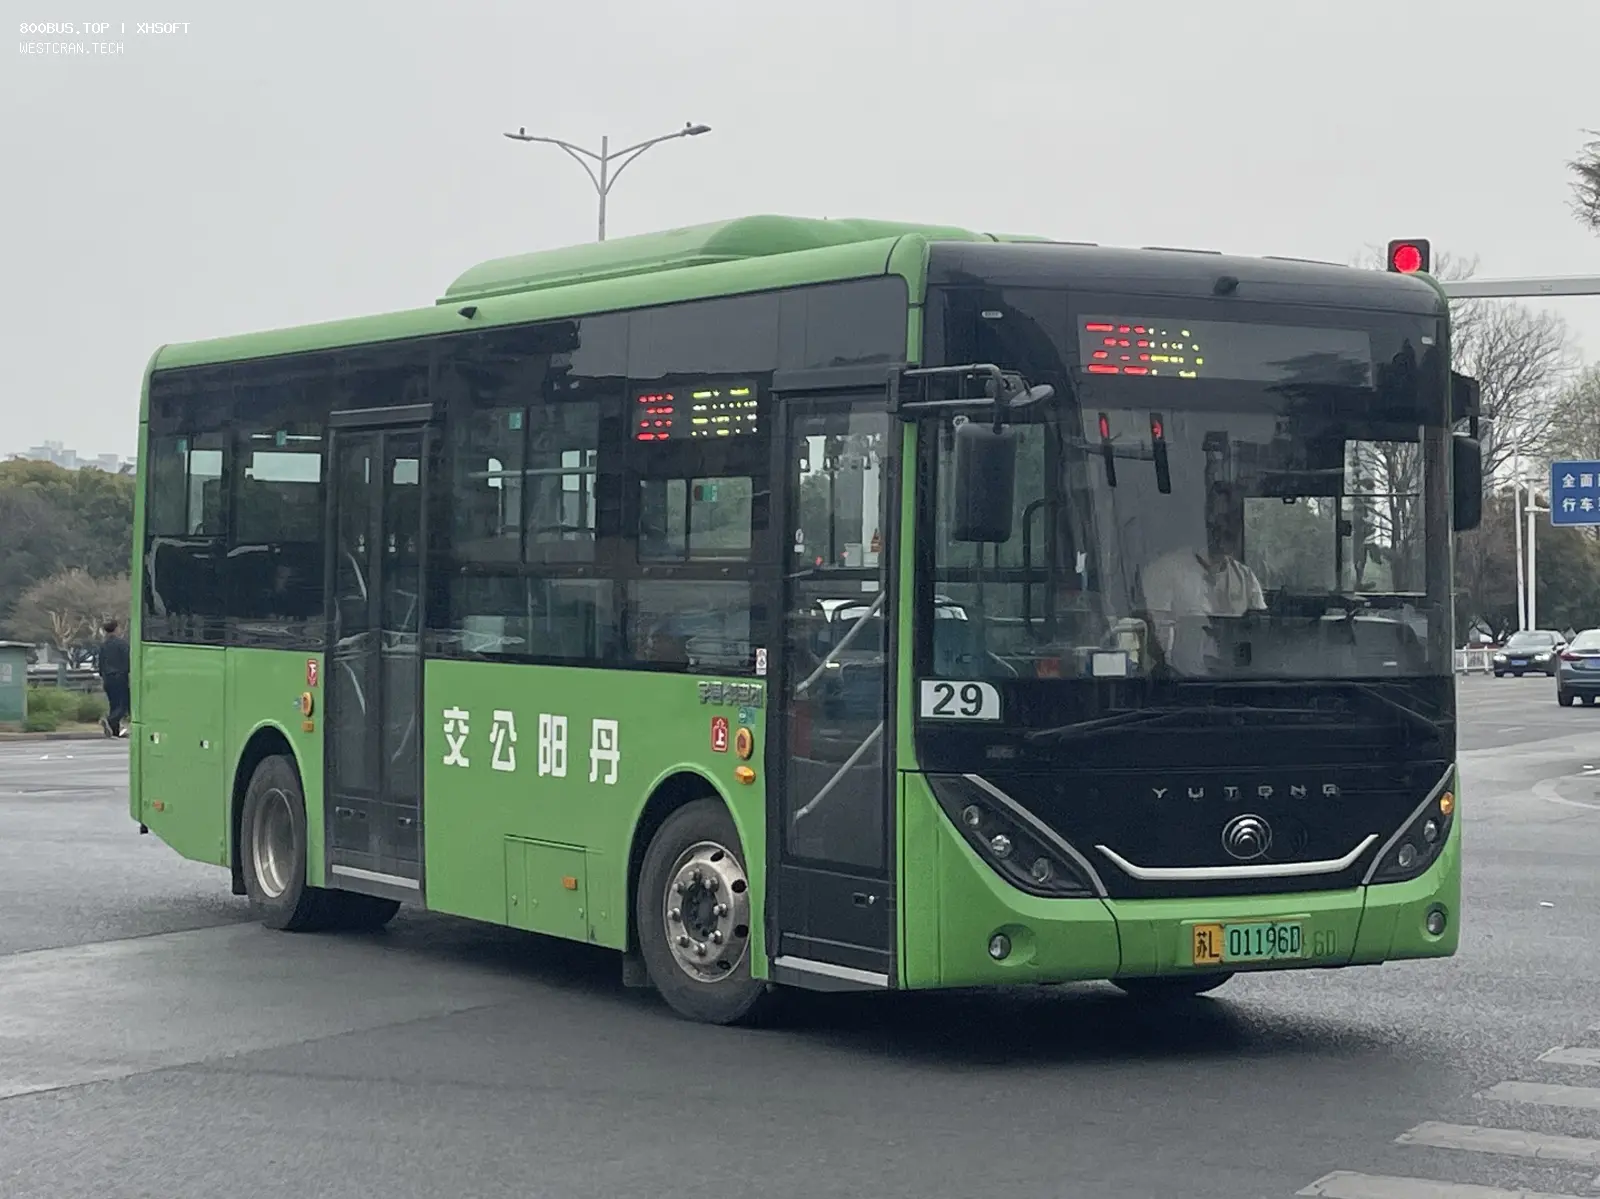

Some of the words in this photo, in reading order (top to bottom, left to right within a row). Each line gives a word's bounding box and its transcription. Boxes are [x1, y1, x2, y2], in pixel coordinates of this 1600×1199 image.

[1562, 473, 1600, 488] 全面
[1562, 497, 1600, 512] 行车
[932, 682, 984, 717] 29
